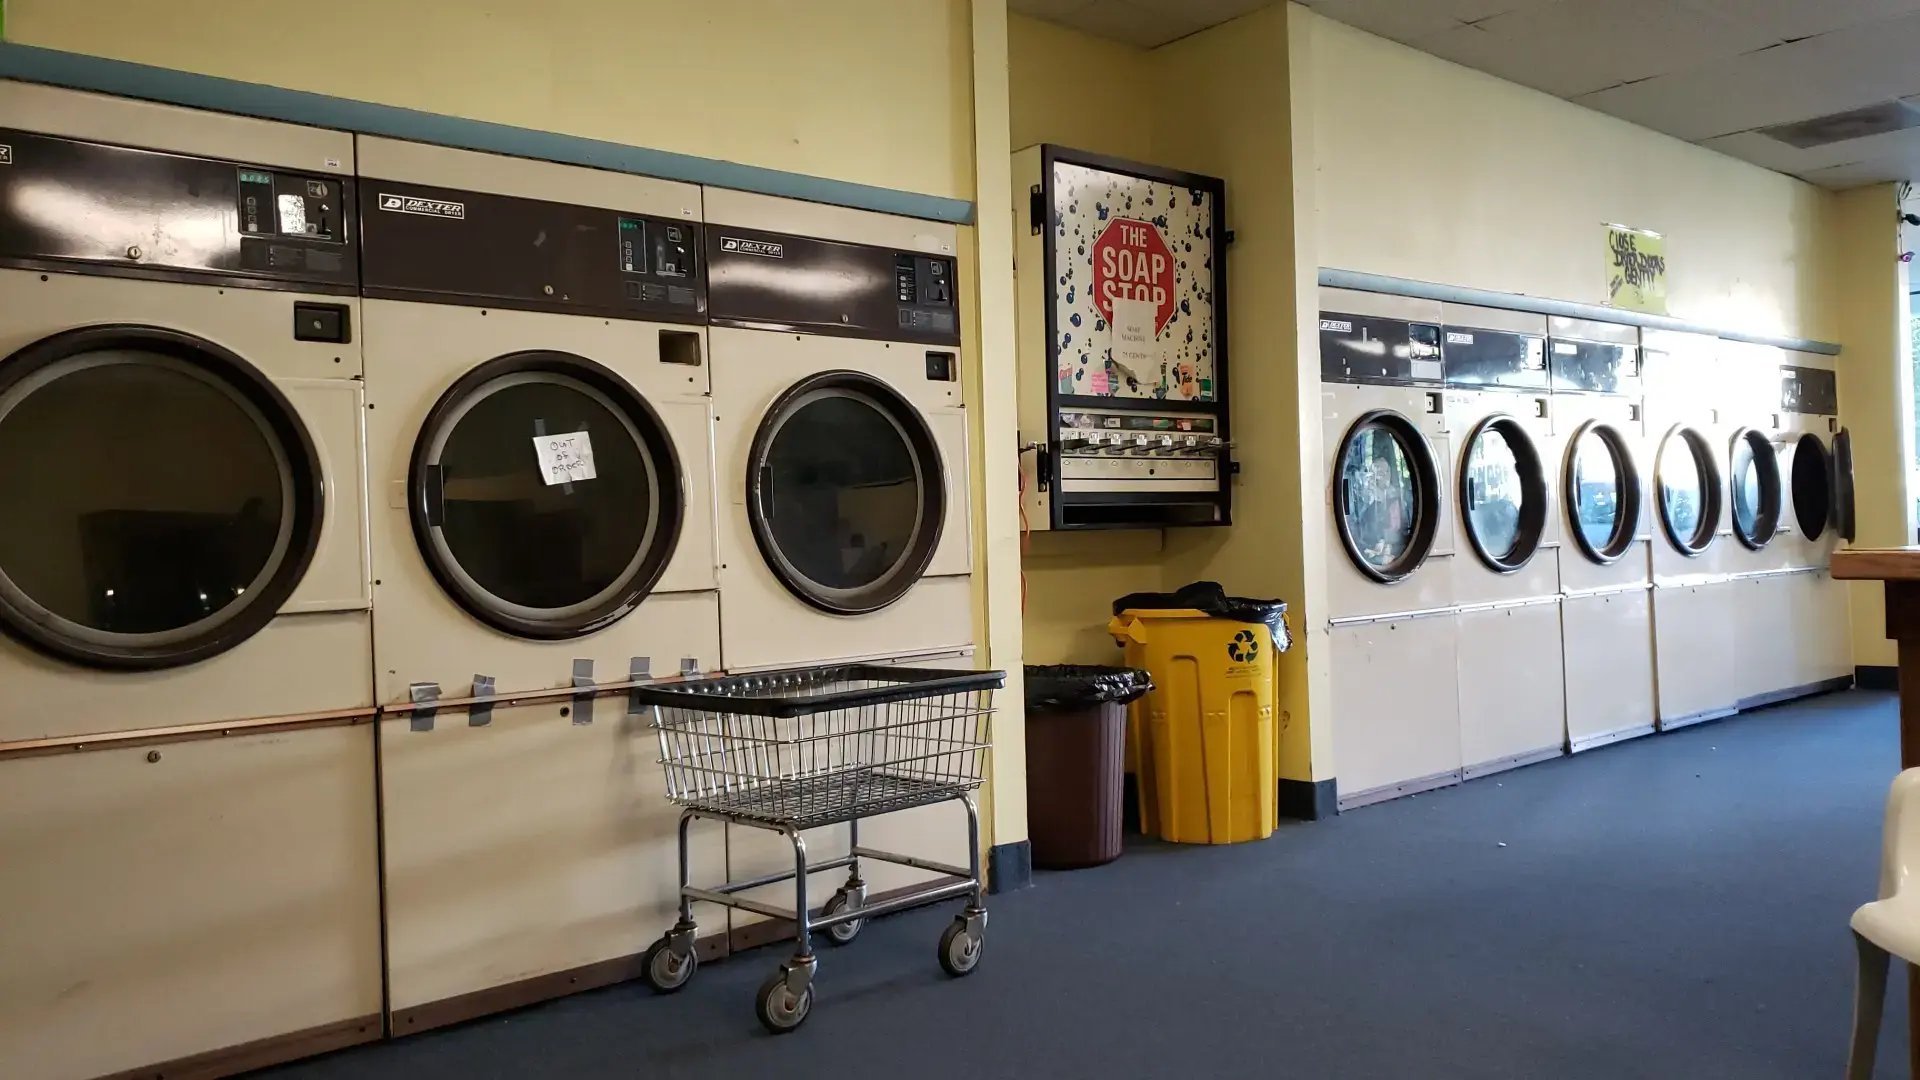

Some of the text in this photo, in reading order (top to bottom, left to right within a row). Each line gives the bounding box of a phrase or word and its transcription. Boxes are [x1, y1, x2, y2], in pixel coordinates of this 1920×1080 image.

[406, 200, 461, 211] DEXTER
[1120, 225, 1147, 248] THE
[740, 242, 780, 252] DEXTER
[1102, 246, 1165, 284] SOAP
[550, 438, 575, 451] OUT
